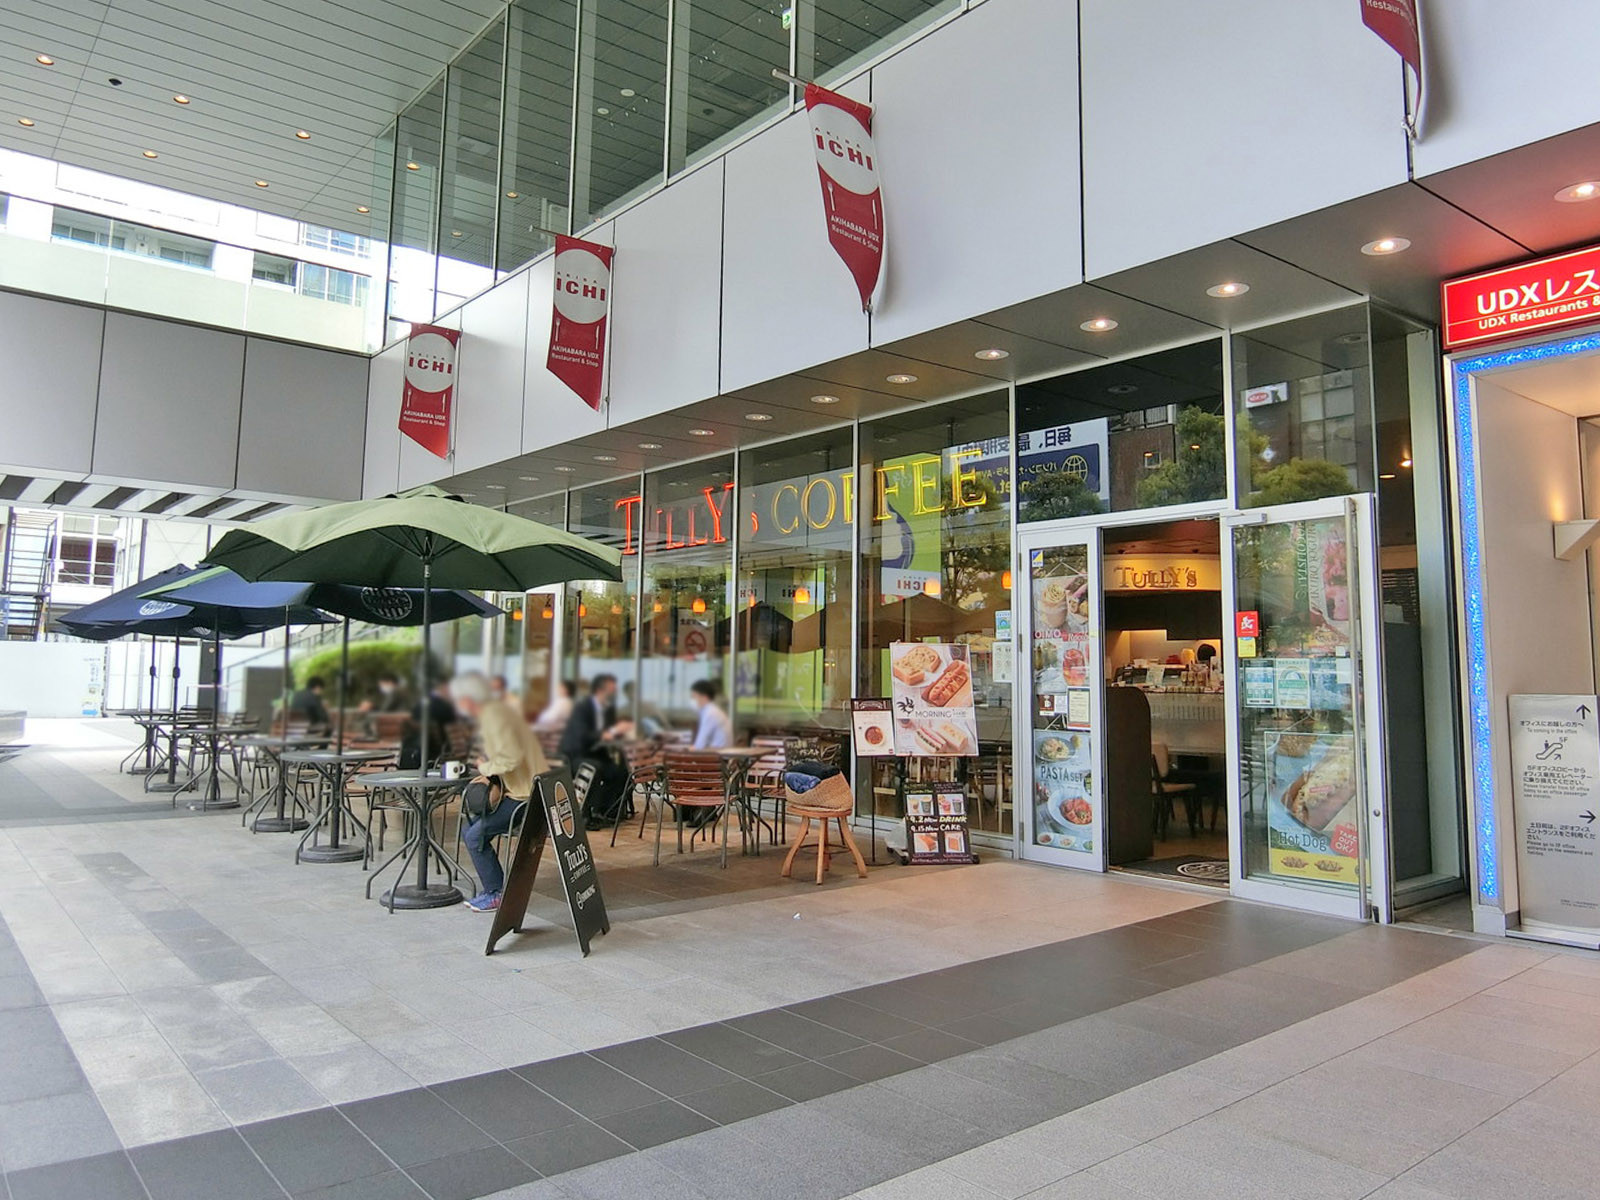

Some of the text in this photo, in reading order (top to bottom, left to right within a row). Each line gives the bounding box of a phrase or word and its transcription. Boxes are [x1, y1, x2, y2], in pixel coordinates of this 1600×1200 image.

[815, 134, 873, 171] ICHI
[830, 215, 880, 243] AKIHABARA UDX
[831, 224, 862, 244] Restaurant
[867, 240, 880, 254] Shop
[556, 277, 606, 302] ICHI
[1479, 315, 1507, 330] UDX
[1510, 300, 1589, 324] Restaurants
[551, 352, 580, 364] Restaurant
[586, 359, 599, 368] Shop
[552, 344, 600, 360] AKIHABARA UDX
[408, 356, 453, 374] ICHI
[403, 409, 435, 420] AKIHABARA
[403, 416, 429, 425] Restaurant
[771, 449, 988, 534] COFFEE
[1041, 766, 1069, 781] PASTA
[939, 815, 968, 823] DRINK
[1279, 832, 1328, 851] Hot Dog
